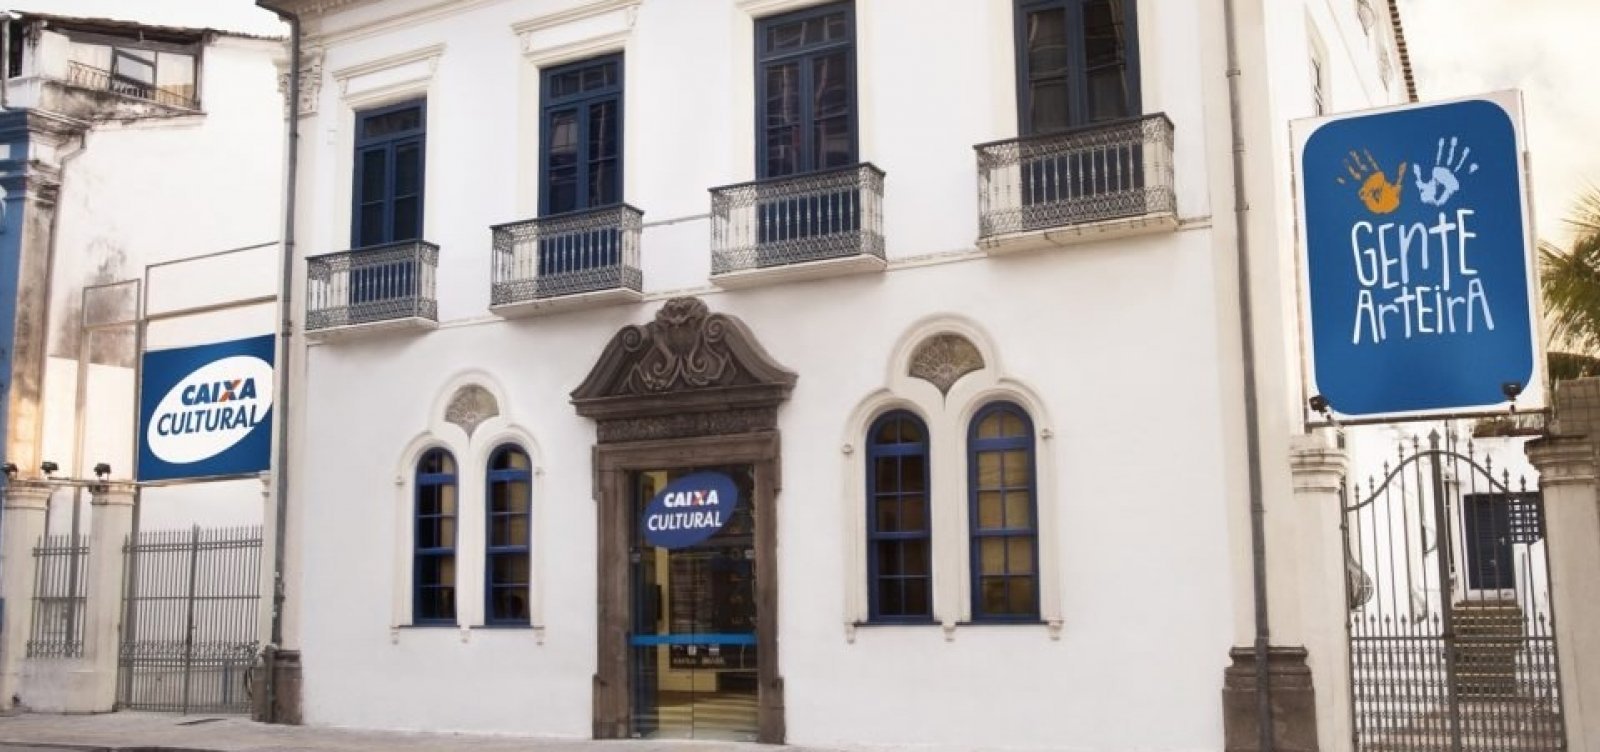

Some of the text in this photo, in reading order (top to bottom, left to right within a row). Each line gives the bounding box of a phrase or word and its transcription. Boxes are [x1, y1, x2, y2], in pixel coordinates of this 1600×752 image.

[181, 377, 257, 406] CAIXA
[157, 404, 258, 436] CULTURAL
[663, 490, 719, 508] CAIXA
[648, 511, 722, 531] CULTURAL
